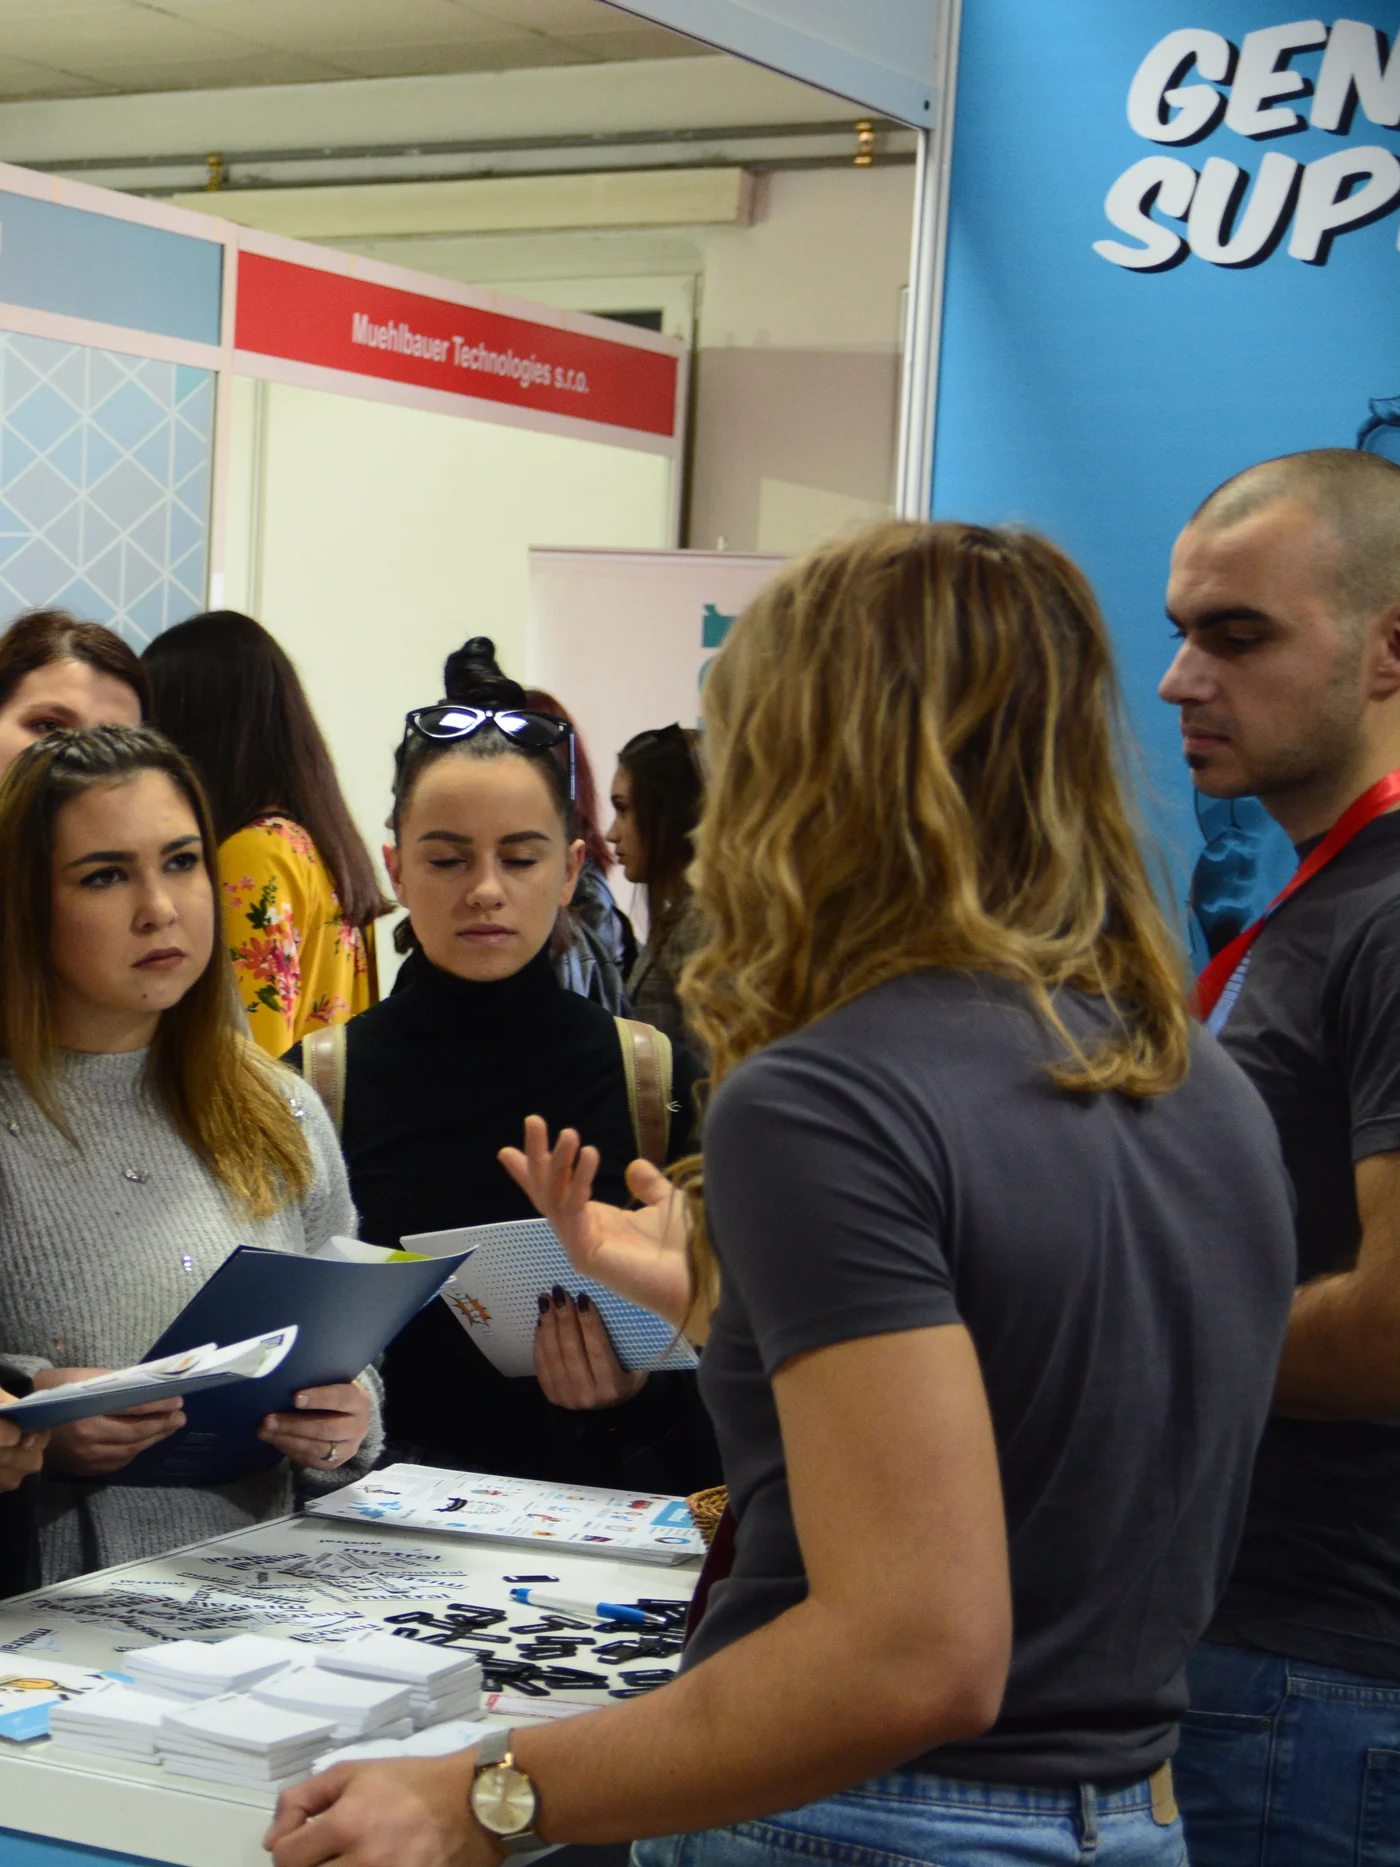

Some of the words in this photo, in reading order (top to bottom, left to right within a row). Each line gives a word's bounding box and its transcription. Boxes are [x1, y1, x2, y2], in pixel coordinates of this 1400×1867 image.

[1092, 146, 1400, 273] SUP
[352, 312, 449, 363] Muehlbauer
[452, 335, 551, 388] Technologies
[554, 365, 589, 393] s.r.o.
[344, 1548, 442, 1561] mistral
[293, 1623, 379, 1640] mistral
